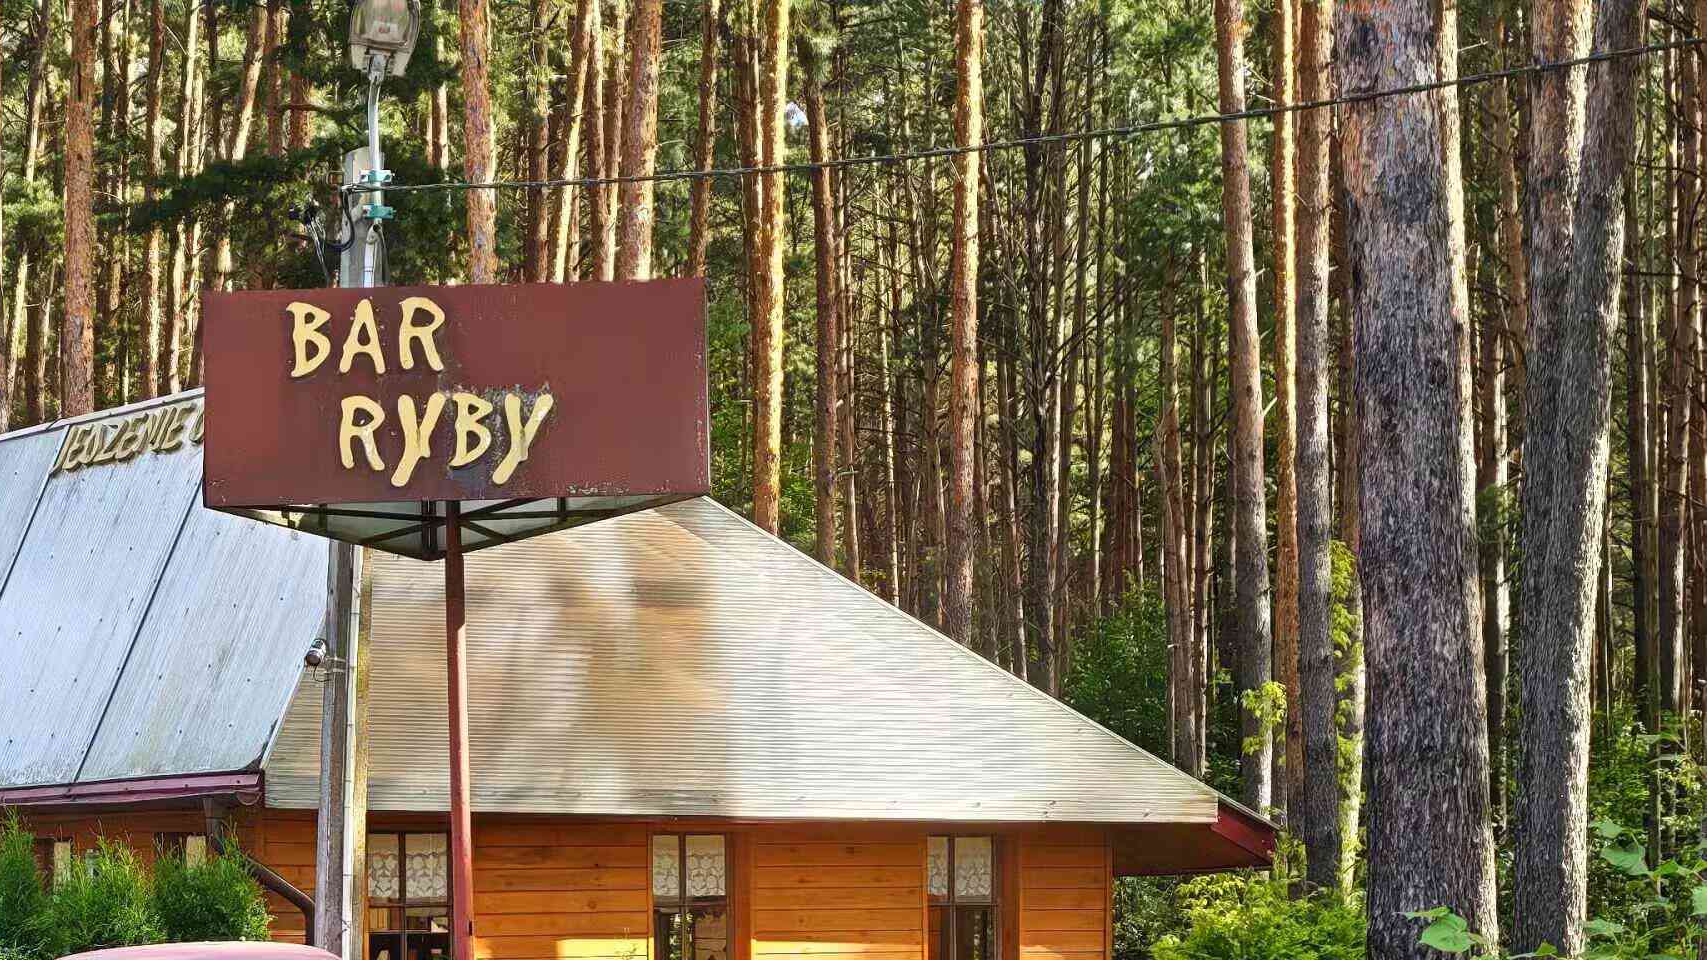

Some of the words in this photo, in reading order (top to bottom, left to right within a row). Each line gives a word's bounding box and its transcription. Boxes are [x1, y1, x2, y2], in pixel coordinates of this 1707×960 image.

[285, 297, 446, 378] BAR
[51, 402, 195, 476] JEDZENIE
[340, 393, 555, 488] RYBY
